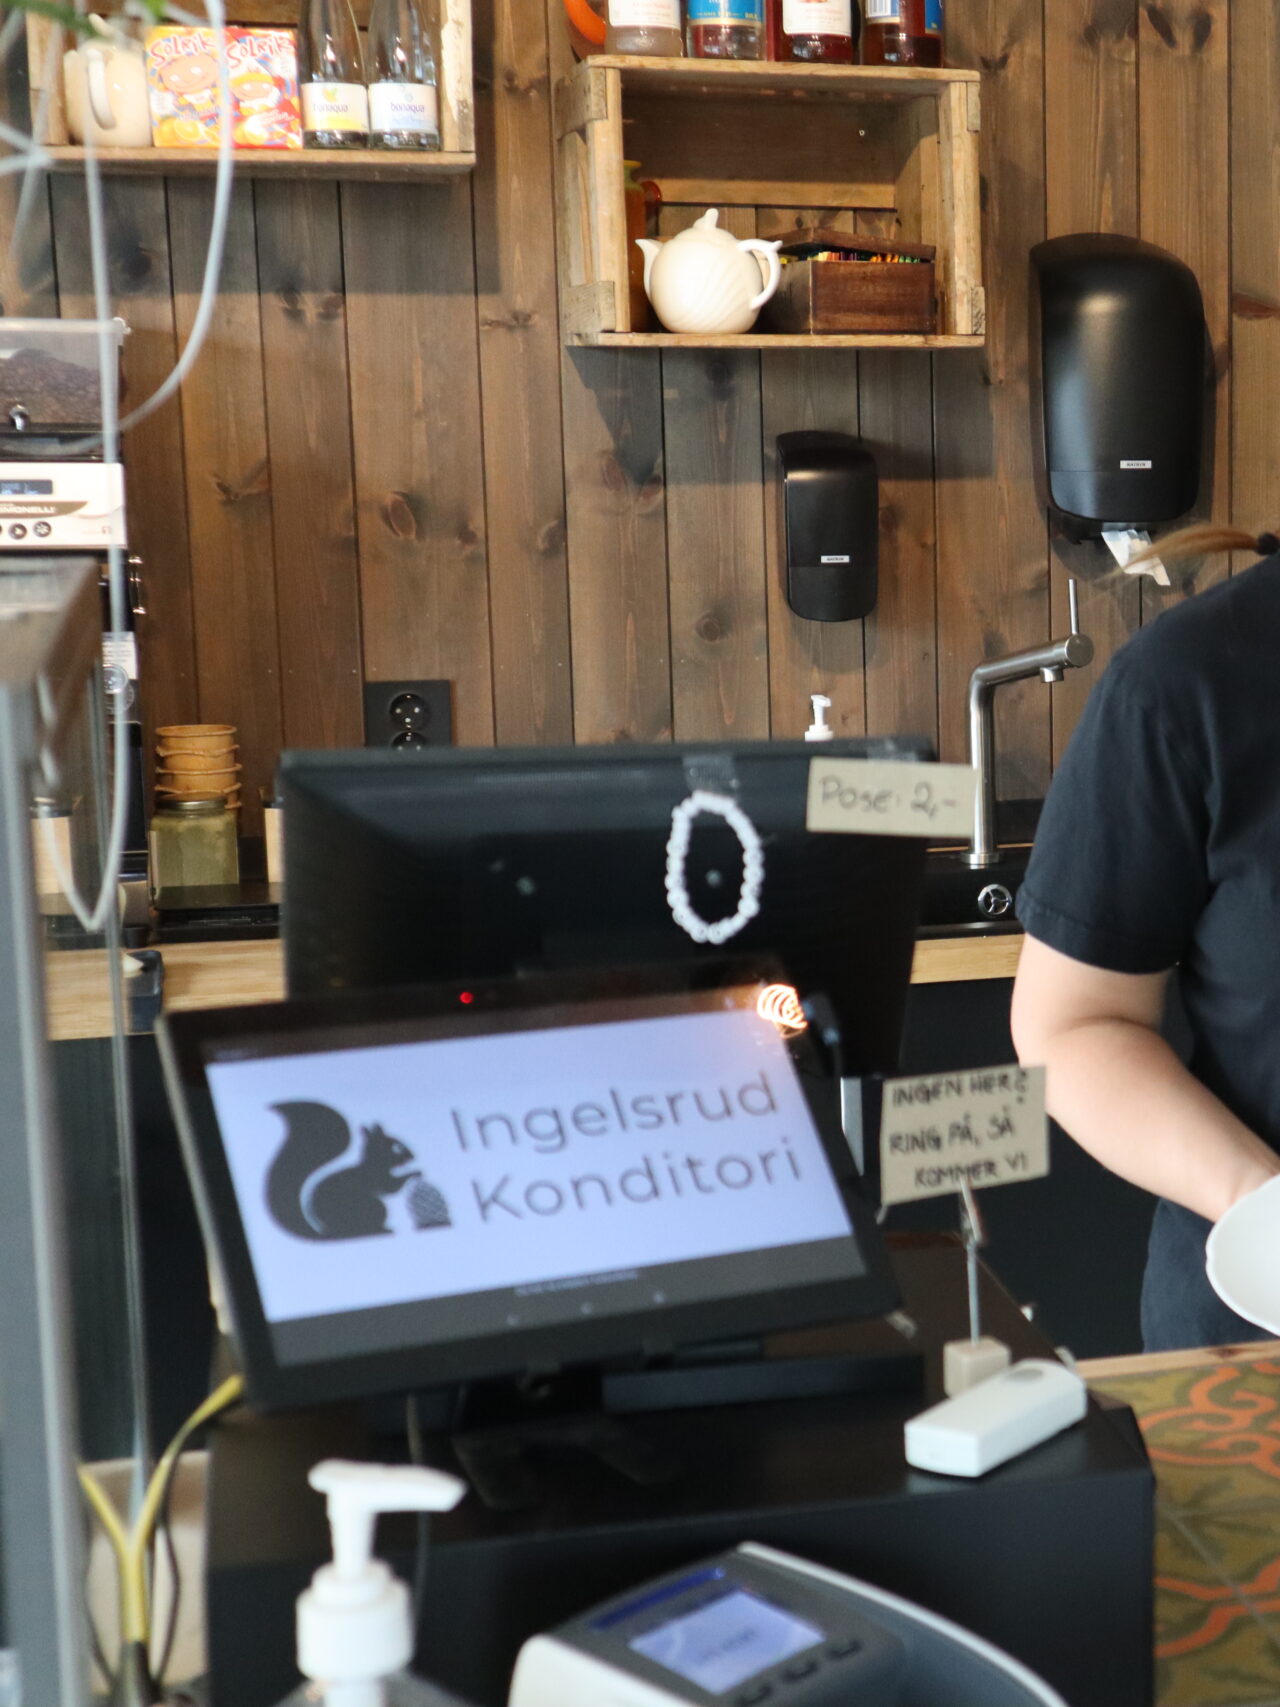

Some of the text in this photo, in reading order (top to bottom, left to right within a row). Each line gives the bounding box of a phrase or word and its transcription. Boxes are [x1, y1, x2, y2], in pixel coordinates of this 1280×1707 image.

[390, 102, 425, 114] bonaqua
[893, 1078, 962, 1107] INGEN
[451, 1069, 778, 1154] Ingelsrud
[890, 1126, 942, 1155] RING
[471, 1136, 802, 1222] Konditori
[914, 1151, 1028, 1189] KOMMER VI
